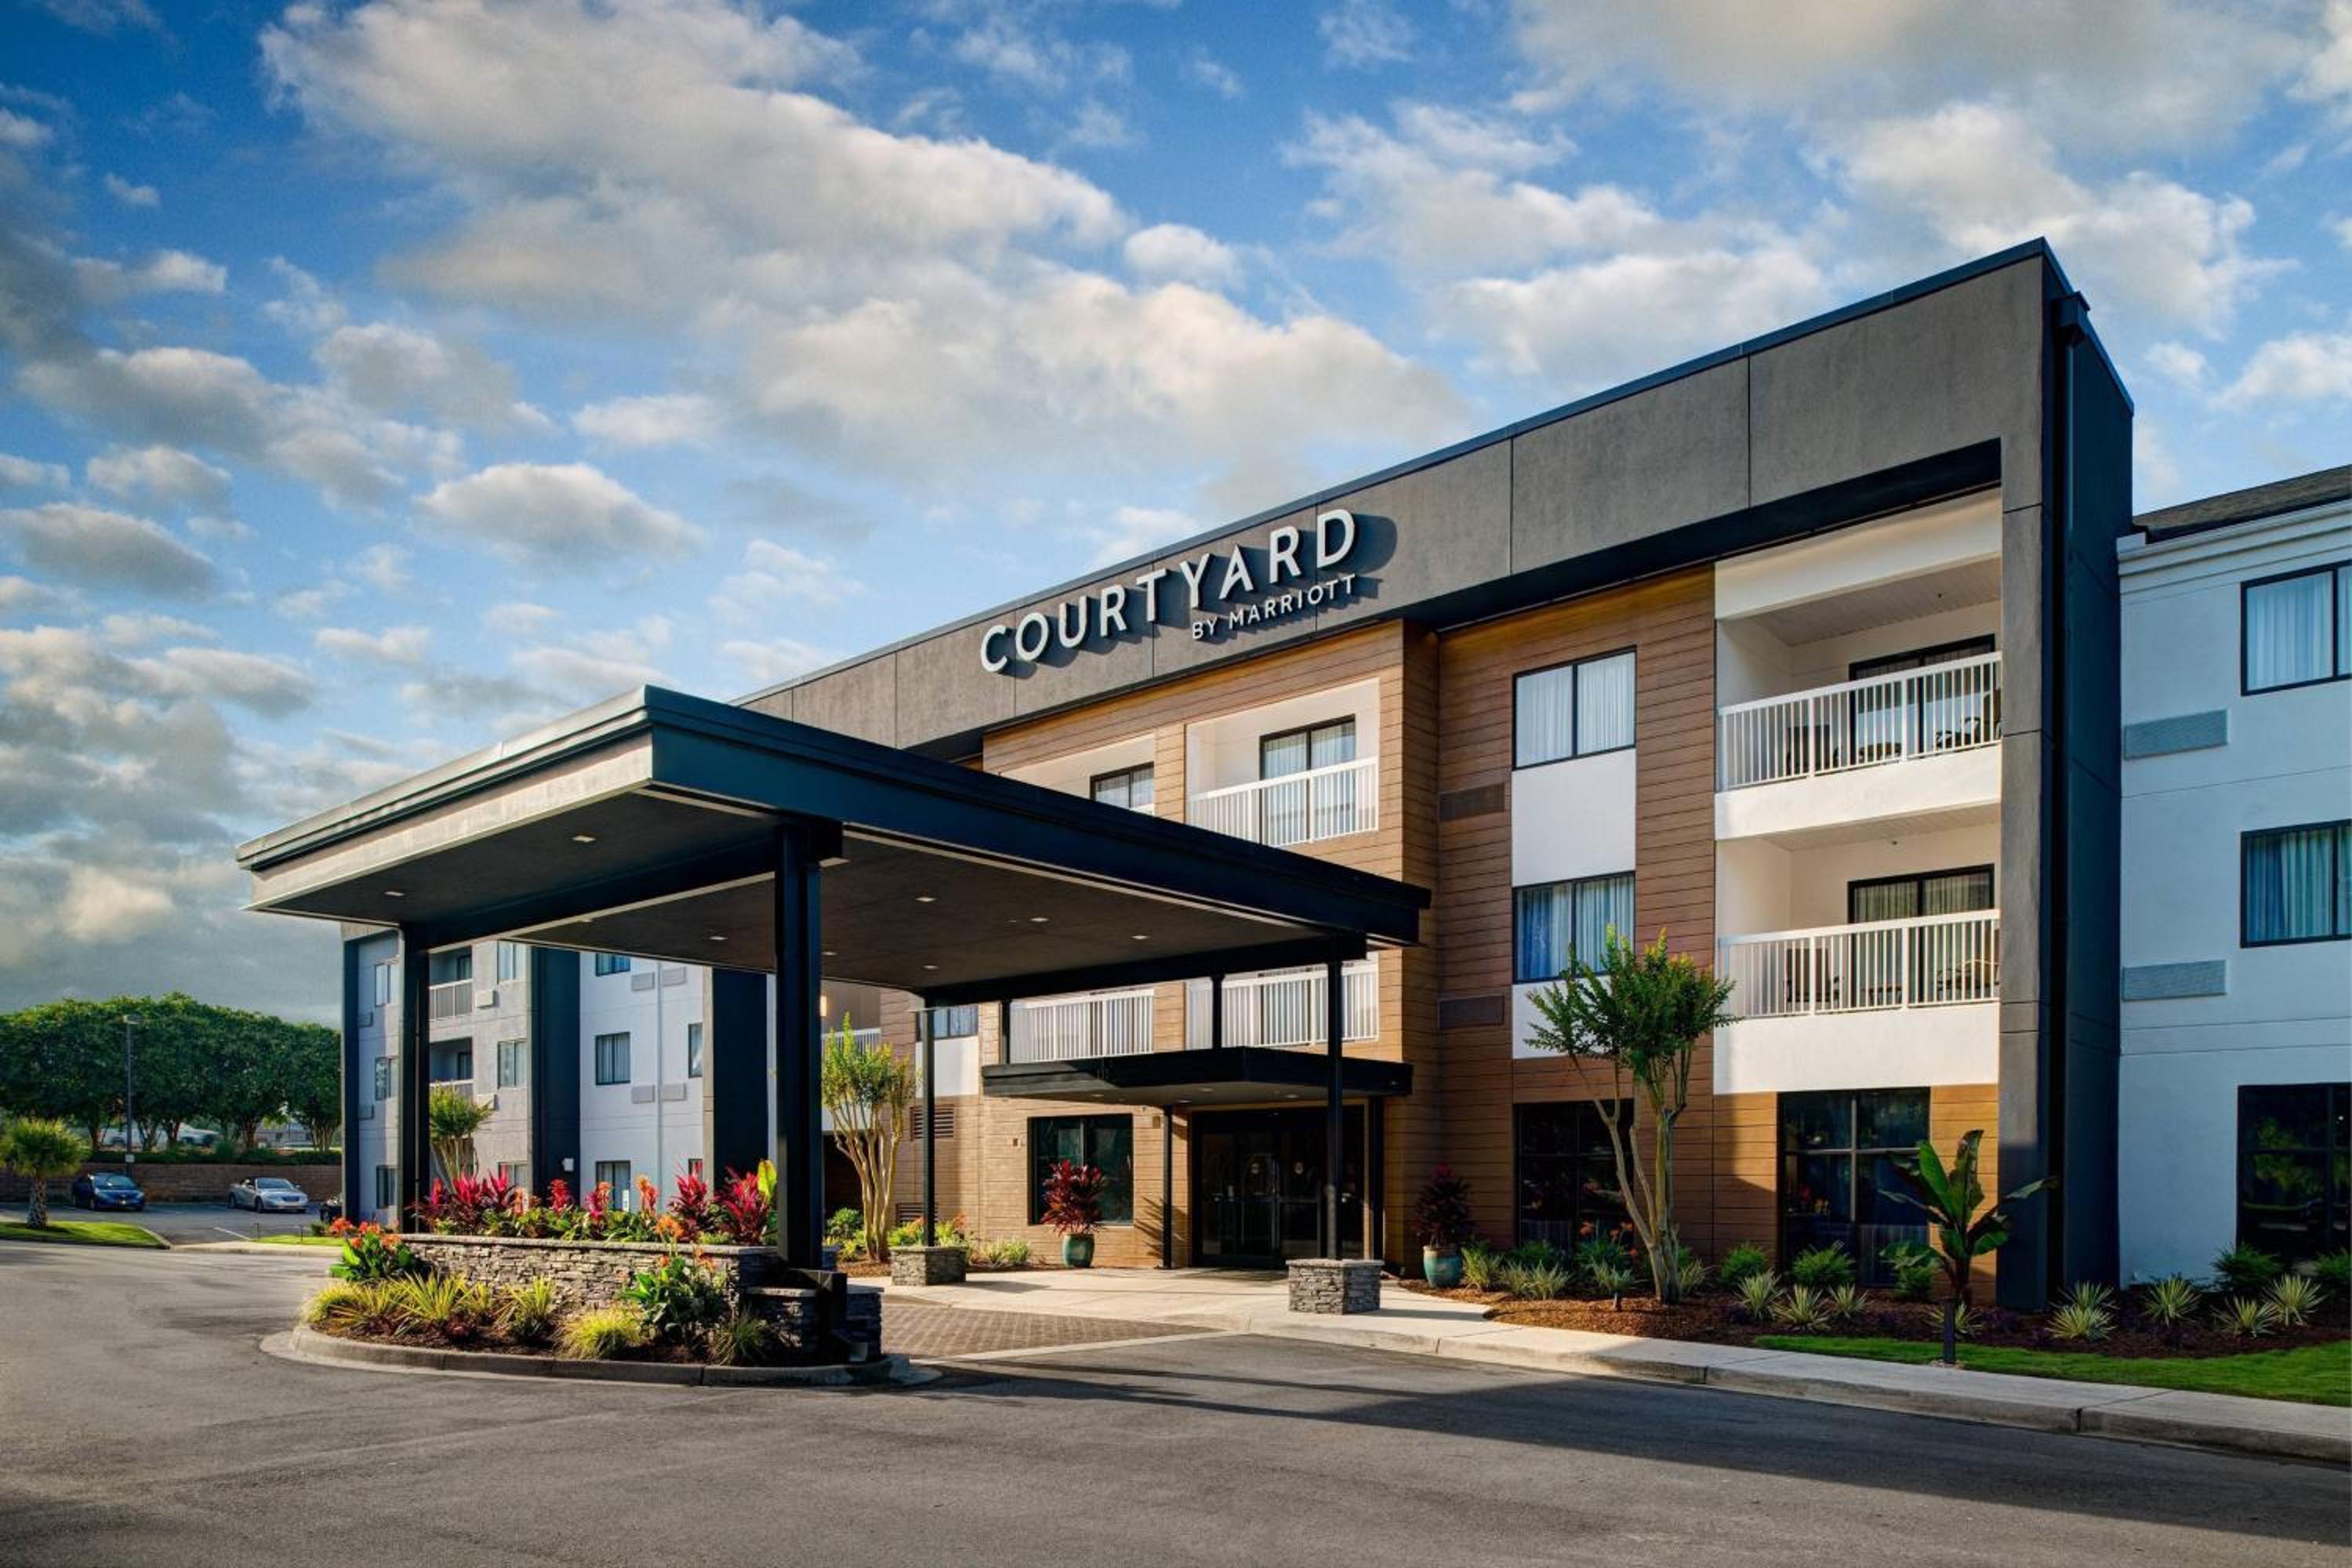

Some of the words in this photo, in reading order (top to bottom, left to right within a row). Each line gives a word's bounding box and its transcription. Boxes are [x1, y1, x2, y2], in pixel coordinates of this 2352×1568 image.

[980, 508, 1356, 673] COURTYARD
[1192, 617, 1217, 640] BY
[1229, 574, 1356, 630] MARRIOTT
